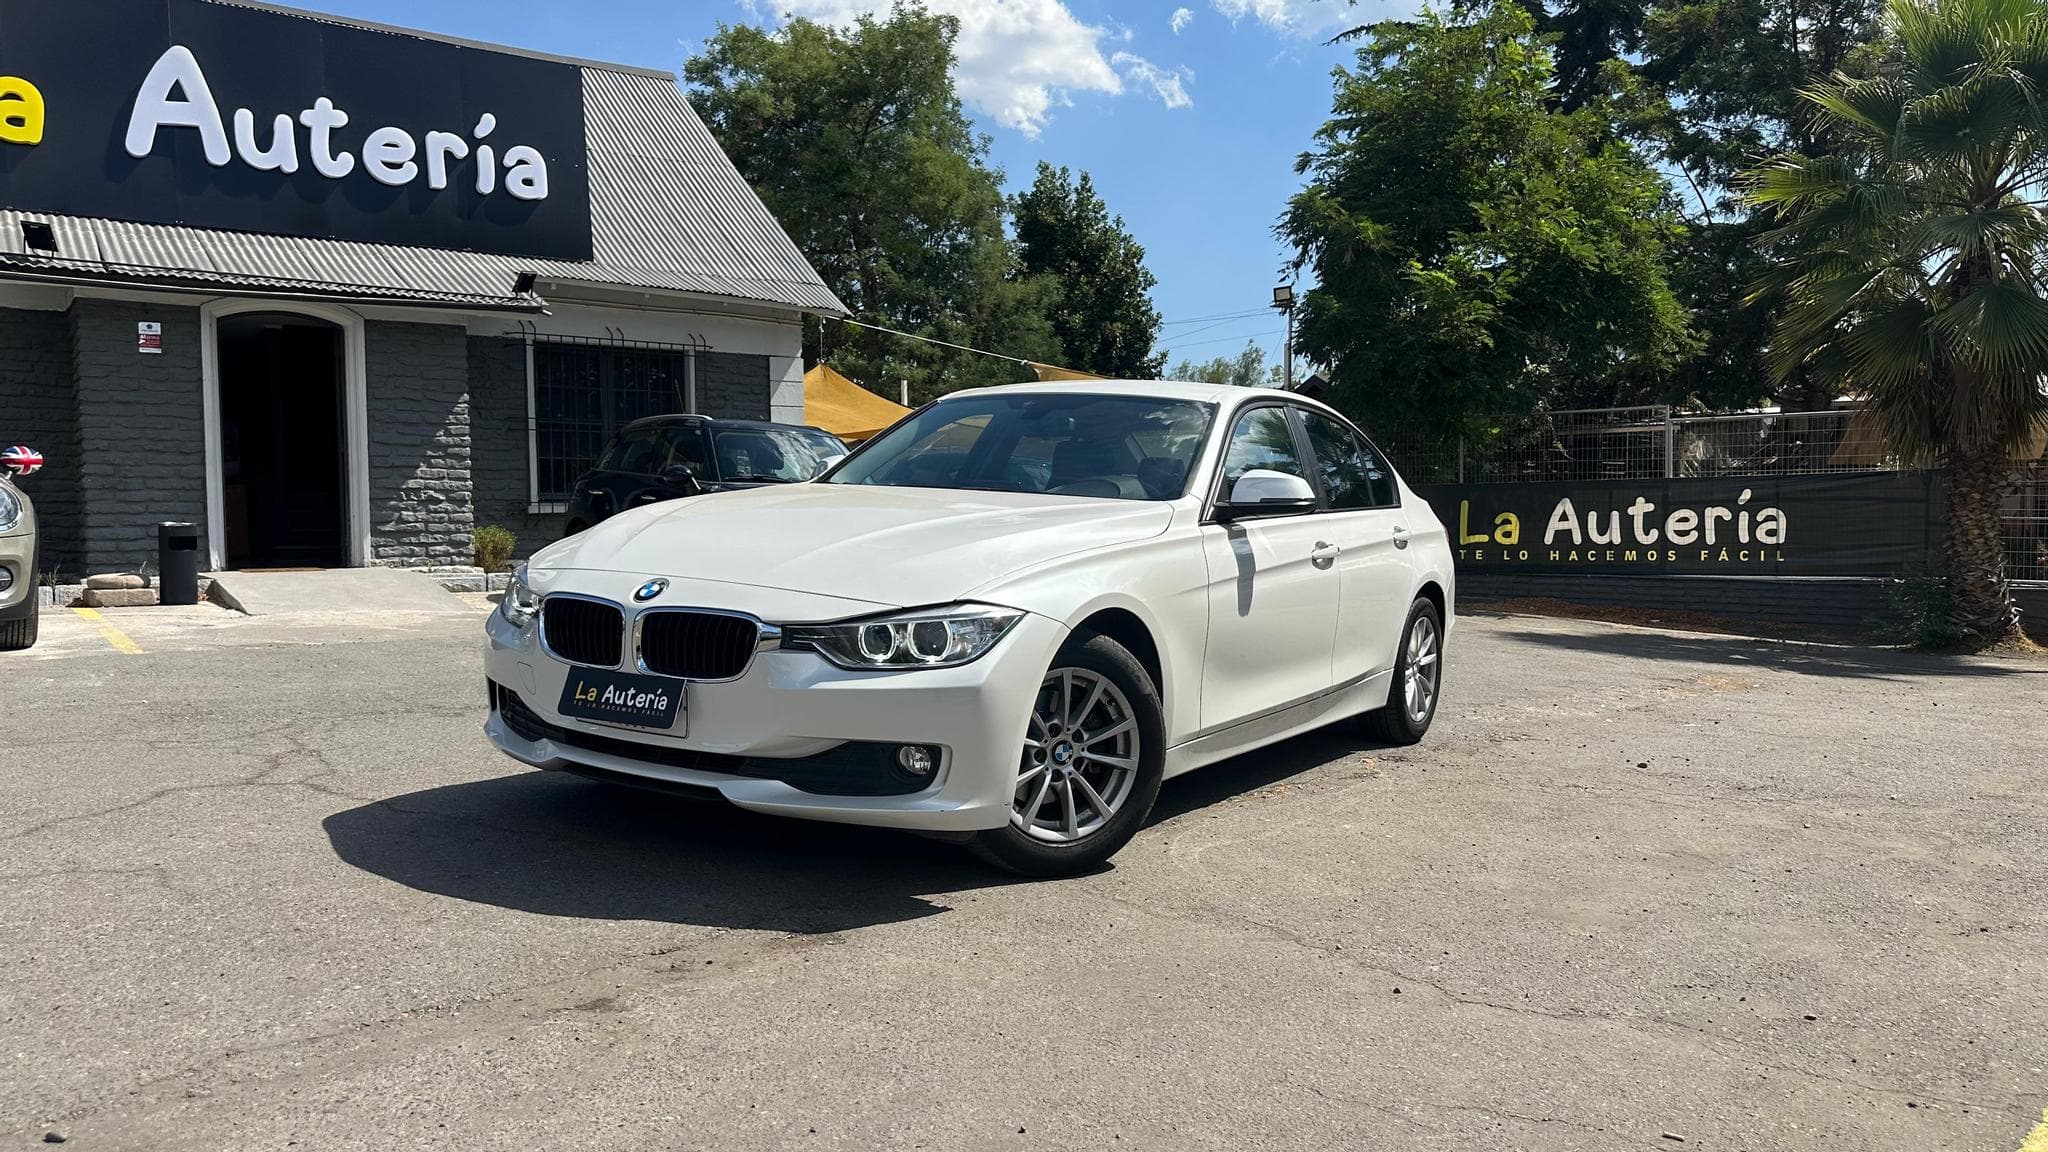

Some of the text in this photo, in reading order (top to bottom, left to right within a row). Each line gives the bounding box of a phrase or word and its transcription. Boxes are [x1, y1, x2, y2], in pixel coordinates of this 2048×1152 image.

[125, 45, 549, 200] Autería
[1460, 489, 1787, 545] La Autería
[1459, 547, 1785, 561] TE LO HACEMOS FÁCIL
[575, 680, 668, 710] La Autería
